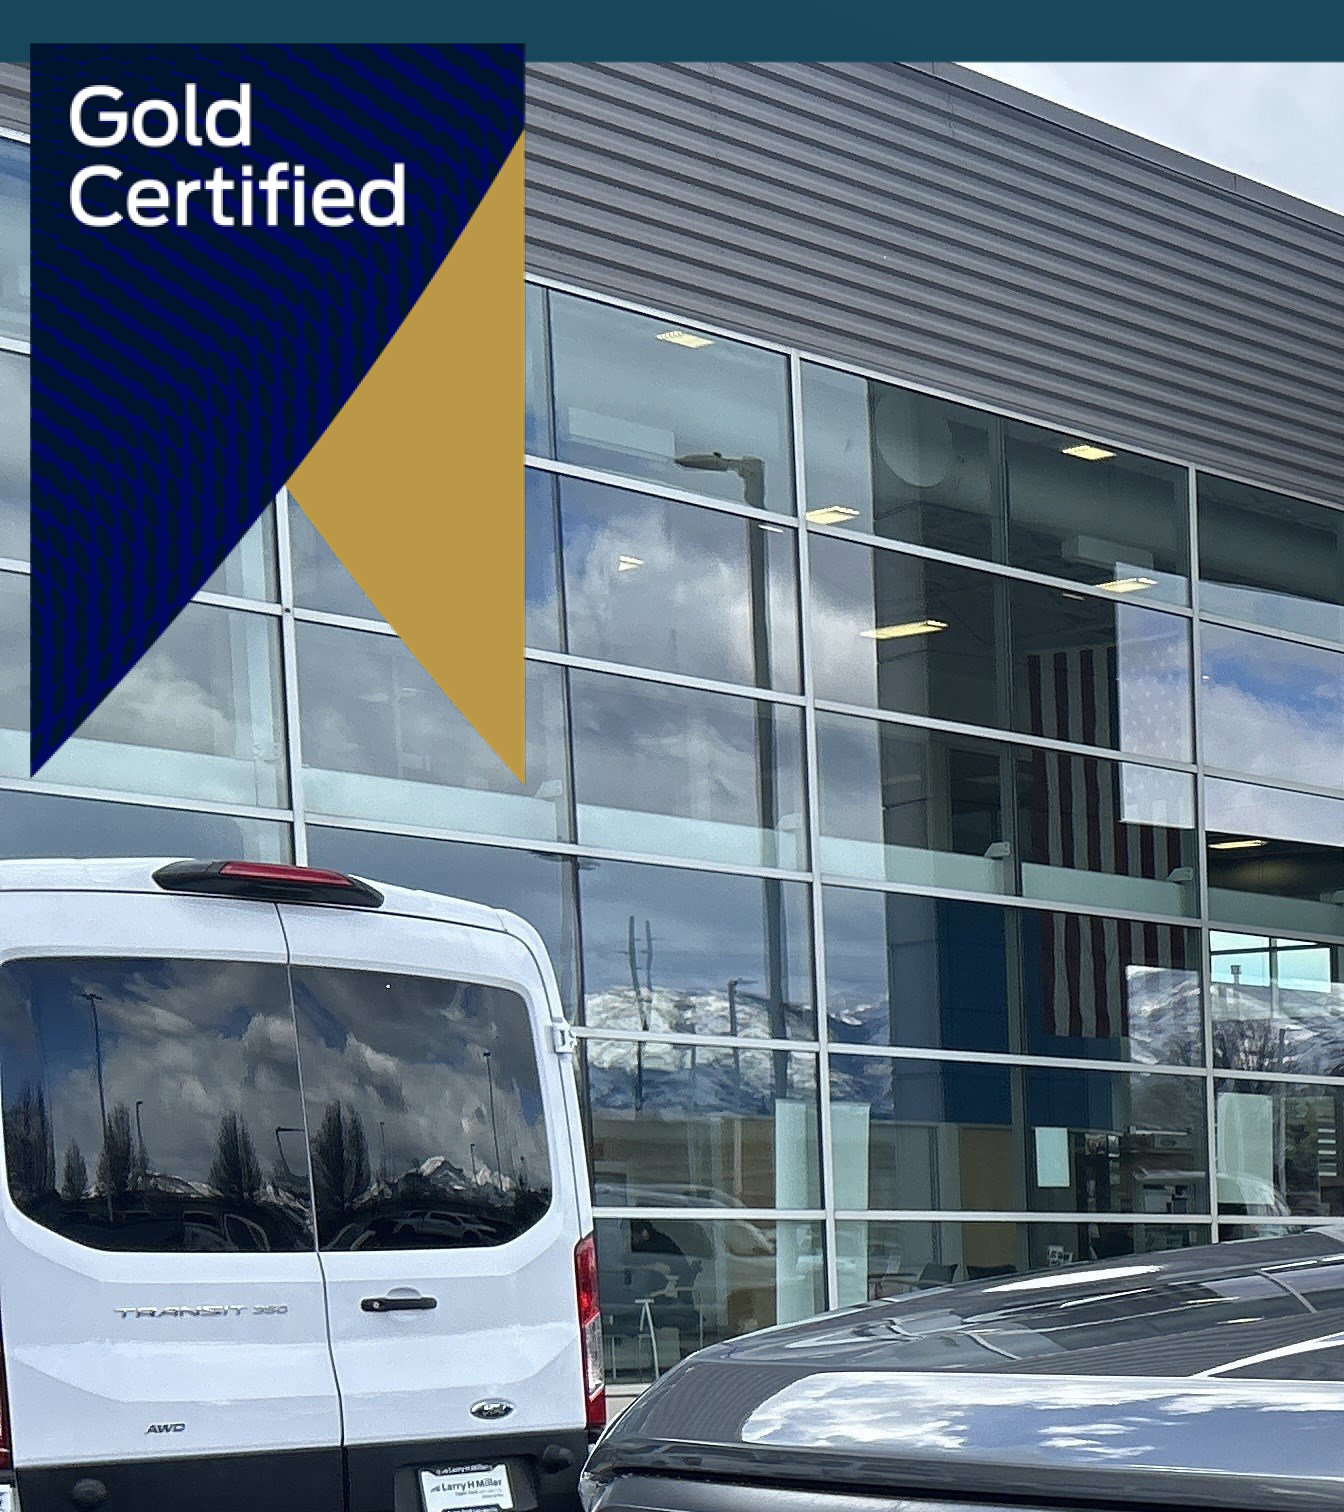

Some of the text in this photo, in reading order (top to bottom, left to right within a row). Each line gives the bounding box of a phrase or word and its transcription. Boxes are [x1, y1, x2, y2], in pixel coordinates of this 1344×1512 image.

[113, 1305, 249, 1319] TRANSIT
[144, 1422, 186, 1434] AWD
[441, 1481, 467, 1492] Larry
[467, 1480, 475, 1489] H
